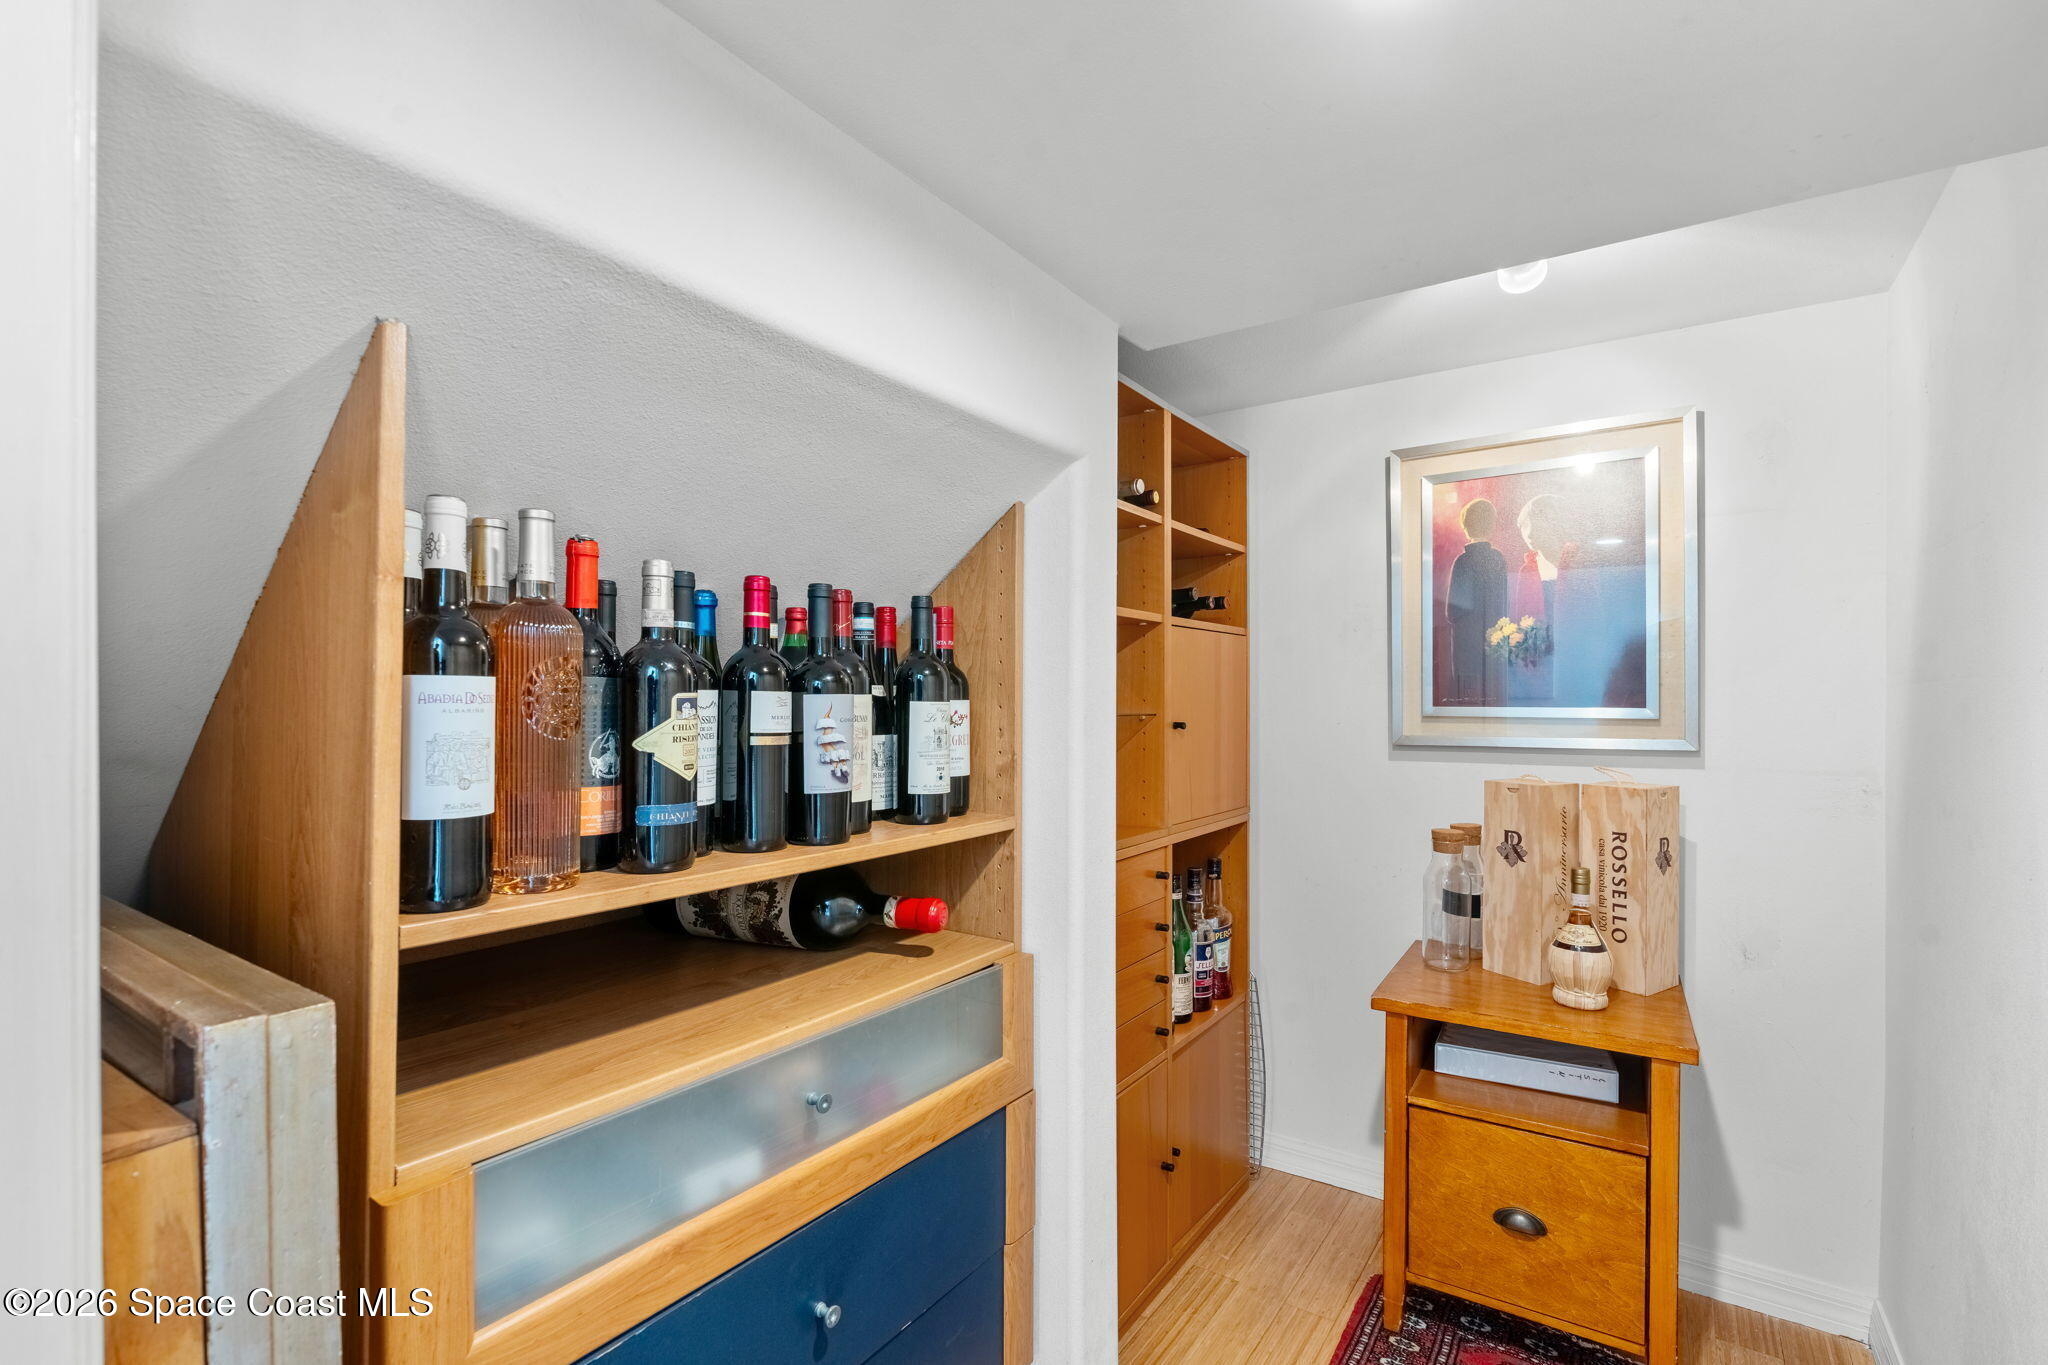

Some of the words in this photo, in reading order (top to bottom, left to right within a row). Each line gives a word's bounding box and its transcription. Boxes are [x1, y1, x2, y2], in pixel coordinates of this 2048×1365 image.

[418, 692, 463, 705] ABADIA
[1598, 838, 1606, 857] casa
[1598, 859, 1608, 893] vinicola
[1611, 831, 1628, 944] ROSSELLO
[1598, 894, 1608, 908] dal
[1598, 910, 1608, 932] 1920
